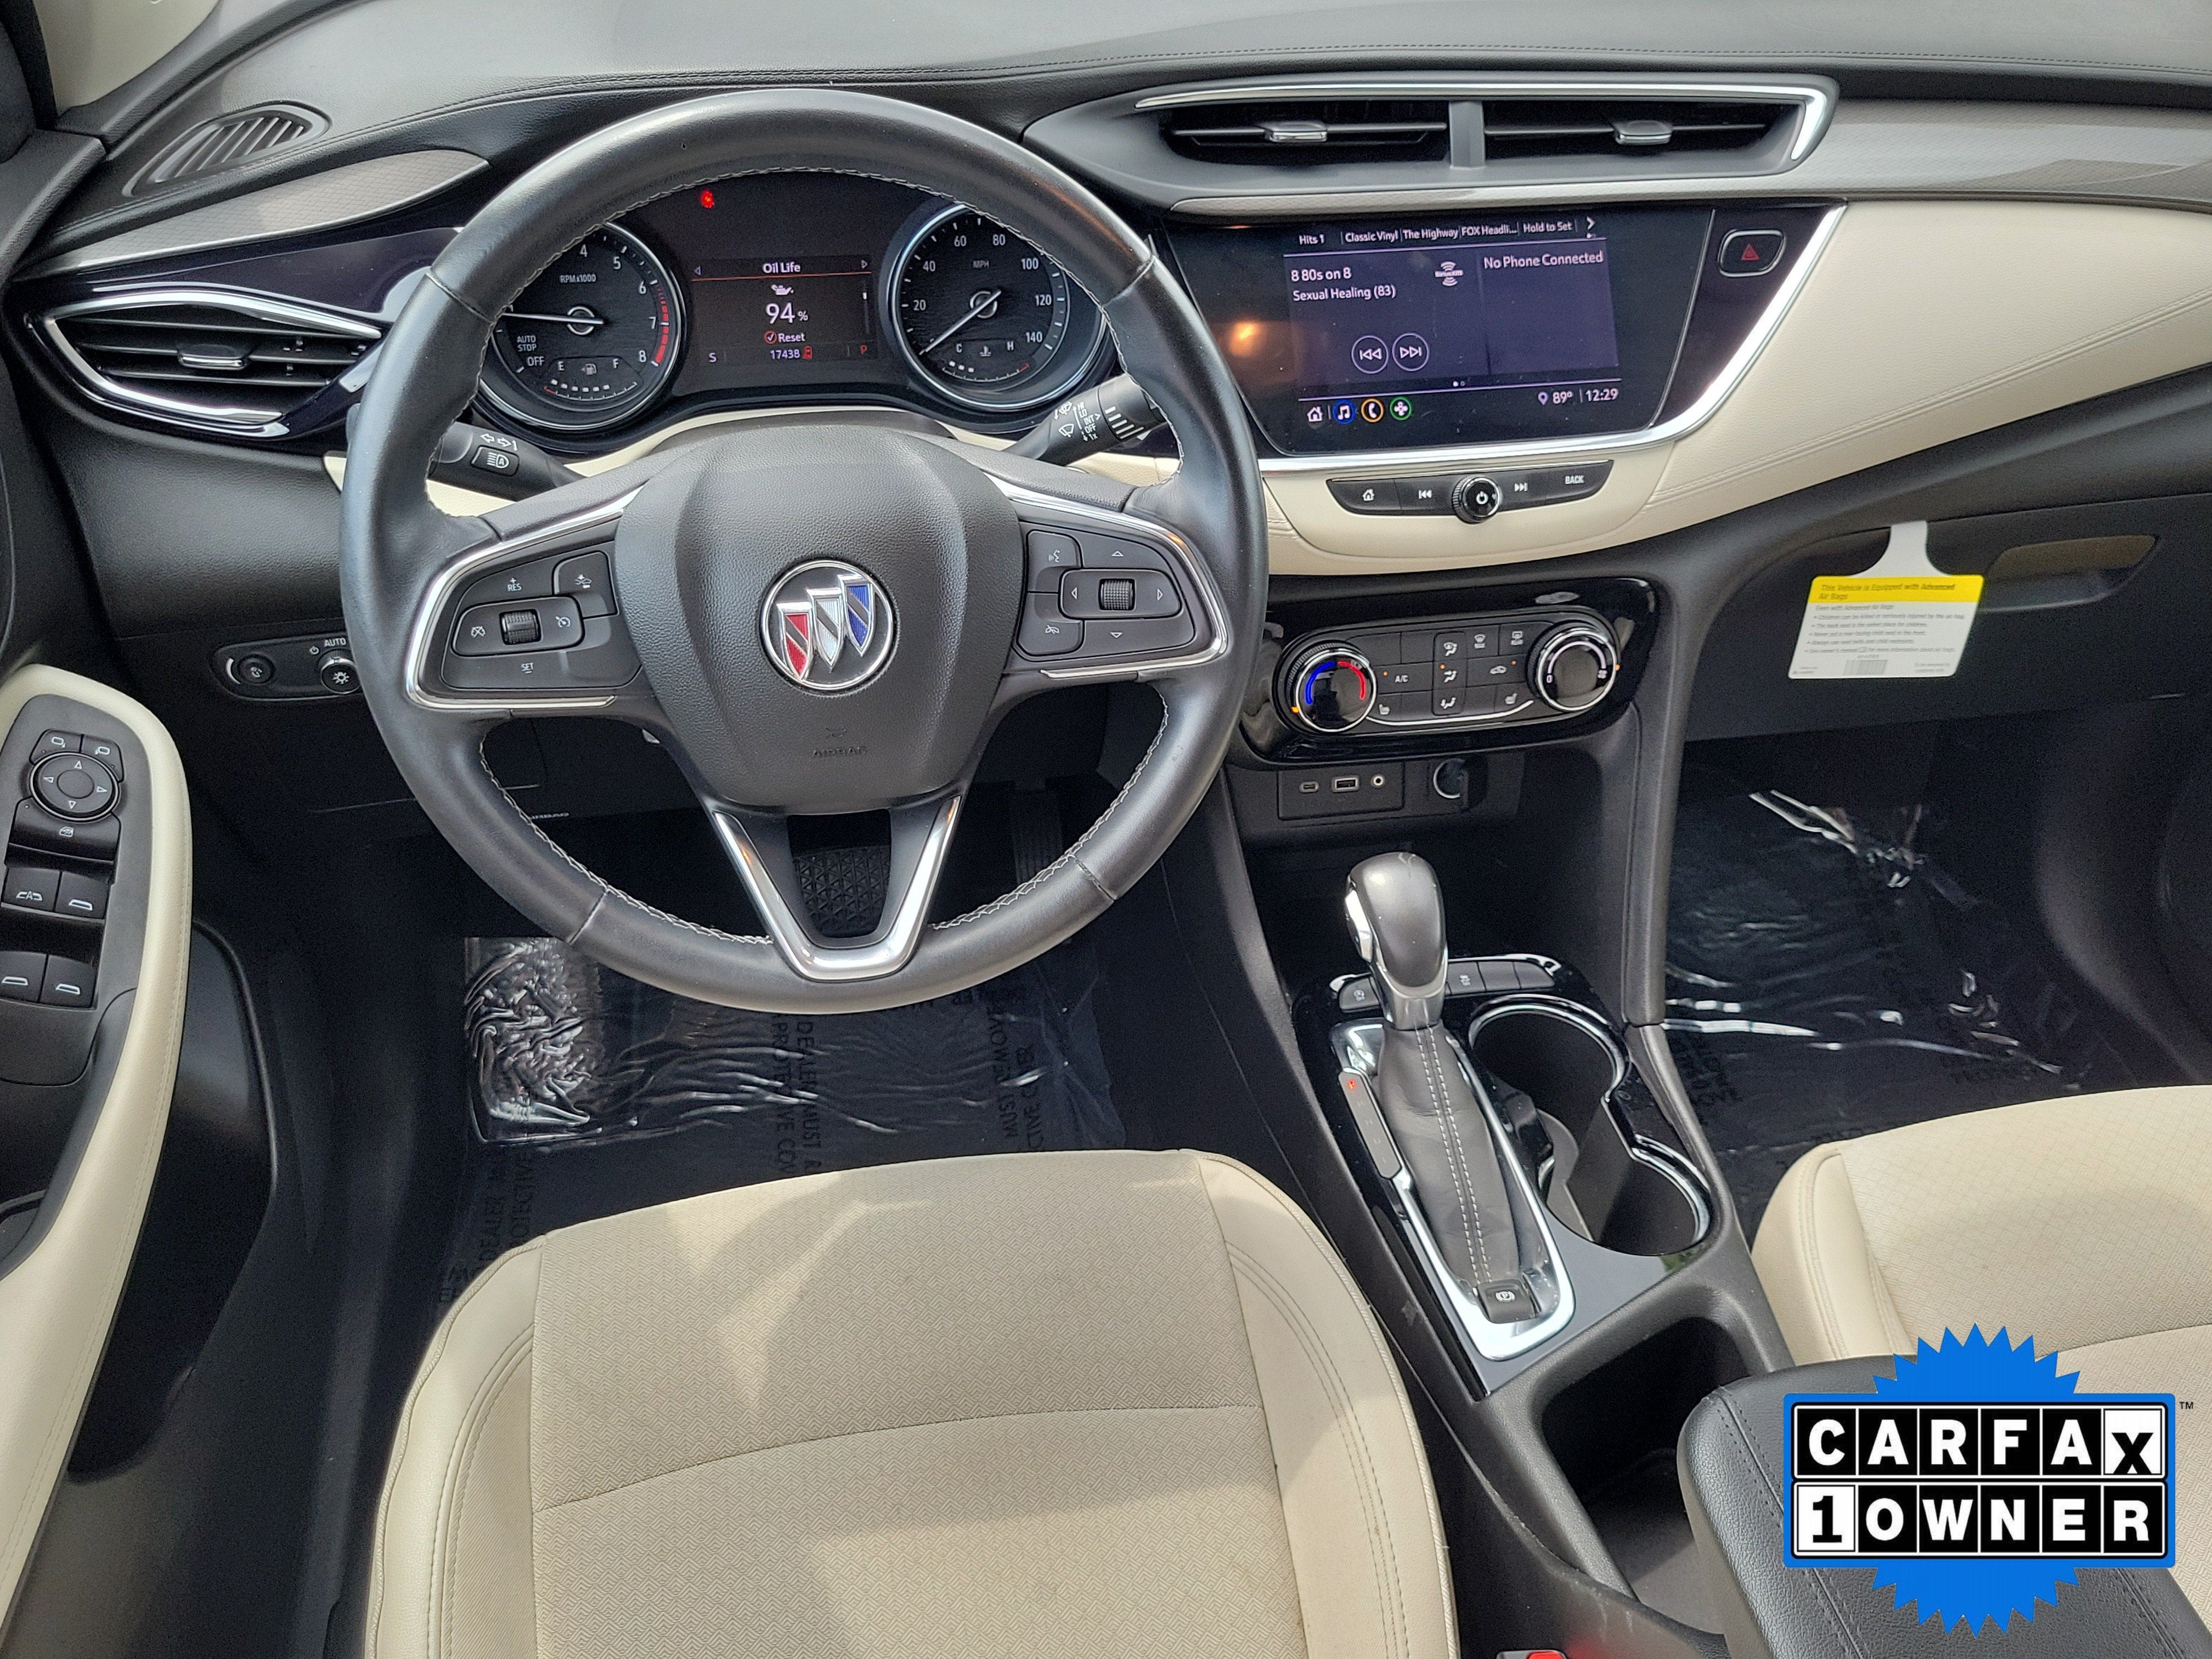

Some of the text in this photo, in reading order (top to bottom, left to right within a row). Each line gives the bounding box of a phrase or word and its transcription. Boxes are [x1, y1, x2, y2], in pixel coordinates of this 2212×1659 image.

[1462, 225, 1481, 236] FOX
[1523, 221, 1572, 233] Hold to Set
[1345, 230, 1398, 243] Classic Vinyl
[1403, 227, 1458, 240] The Highway
[954, 235, 967, 247] 60
[992, 234, 1006, 246] 80
[1299, 234, 1324, 245] Hits 1
[579, 244, 588, 257] 4
[613, 257, 621, 269] 5
[973, 260, 989, 268] MPH
[1022, 258, 1039, 270] 100
[1484, 250, 1604, 269] No Phone Connected
[763, 261, 801, 274] Oil Life
[923, 261, 936, 272] 40
[1291, 267, 1352, 281] 8 80s on 8
[639, 281, 646, 295] 6
[1293, 284, 1396, 301] Sexual Healing (83)
[913, 300, 926, 311] 20
[1035, 295, 1052, 306] 120
[766, 302, 795, 324] 94
[648, 317, 657, 329] 7
[517, 335, 536, 344] AUTO
[778, 333, 805, 342] Reset
[1026, 332, 1042, 343] 140
[517, 343, 537, 352] STOP
[956, 343, 962, 353] C
[1007, 341, 1014, 351] H
[639, 351, 646, 363] 8
[709, 353, 716, 363] S
[770, 349, 800, 359] 17438
[527, 356, 544, 366] OFF
[558, 361, 565, 371] E
[613, 358, 619, 369] F
[1585, 388, 1618, 402] 12:29
[1077, 401, 1085, 410] HI
[1079, 409, 1088, 418] LO
[1084, 415, 1095, 425] INT
[1084, 424, 1096, 433] OFF
[1565, 475, 1584, 484] BACK
[507, 583, 522, 591] RES
[324, 637, 346, 647] AUTO
[521, 663, 534, 671] SET
[1395, 675, 1408, 683] A/C
